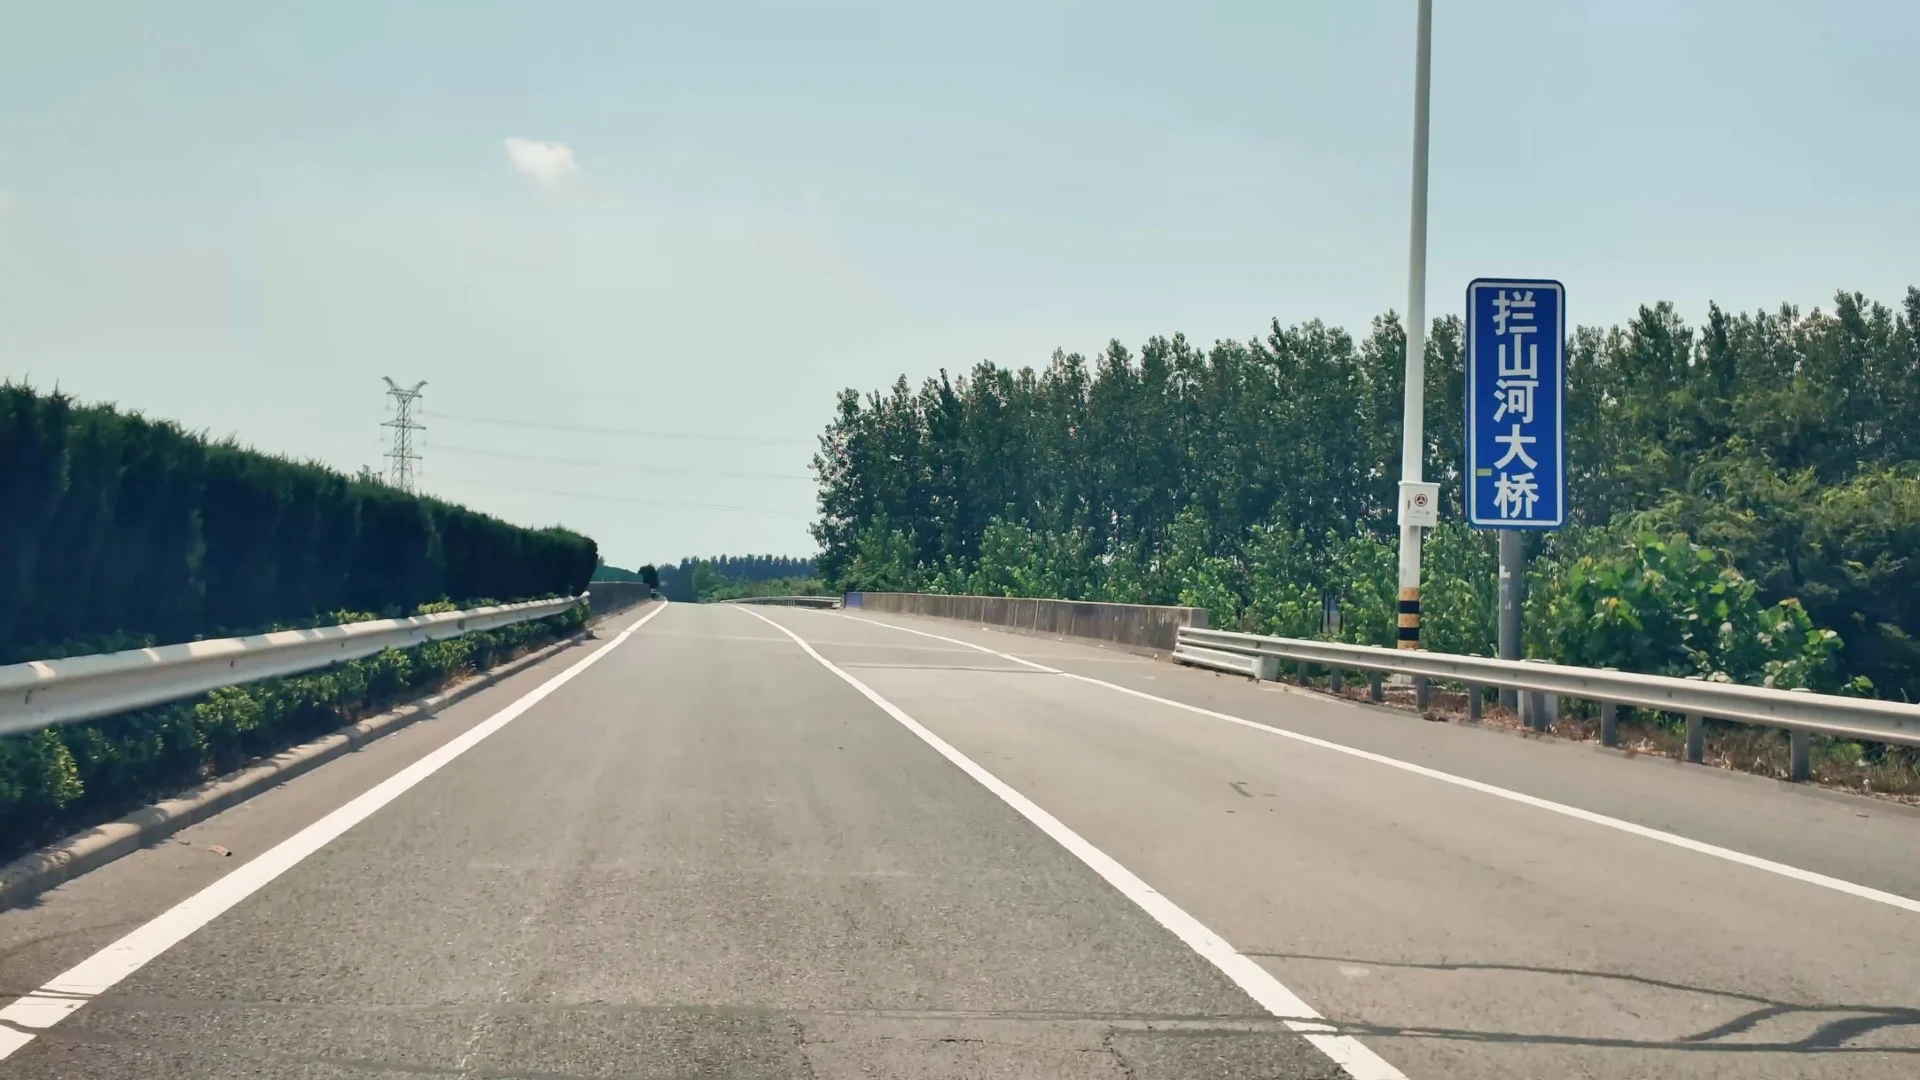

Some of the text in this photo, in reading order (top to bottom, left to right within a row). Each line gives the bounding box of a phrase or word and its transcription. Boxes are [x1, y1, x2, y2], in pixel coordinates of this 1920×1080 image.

[1492, 290, 1539, 518] 拦山河大桥
